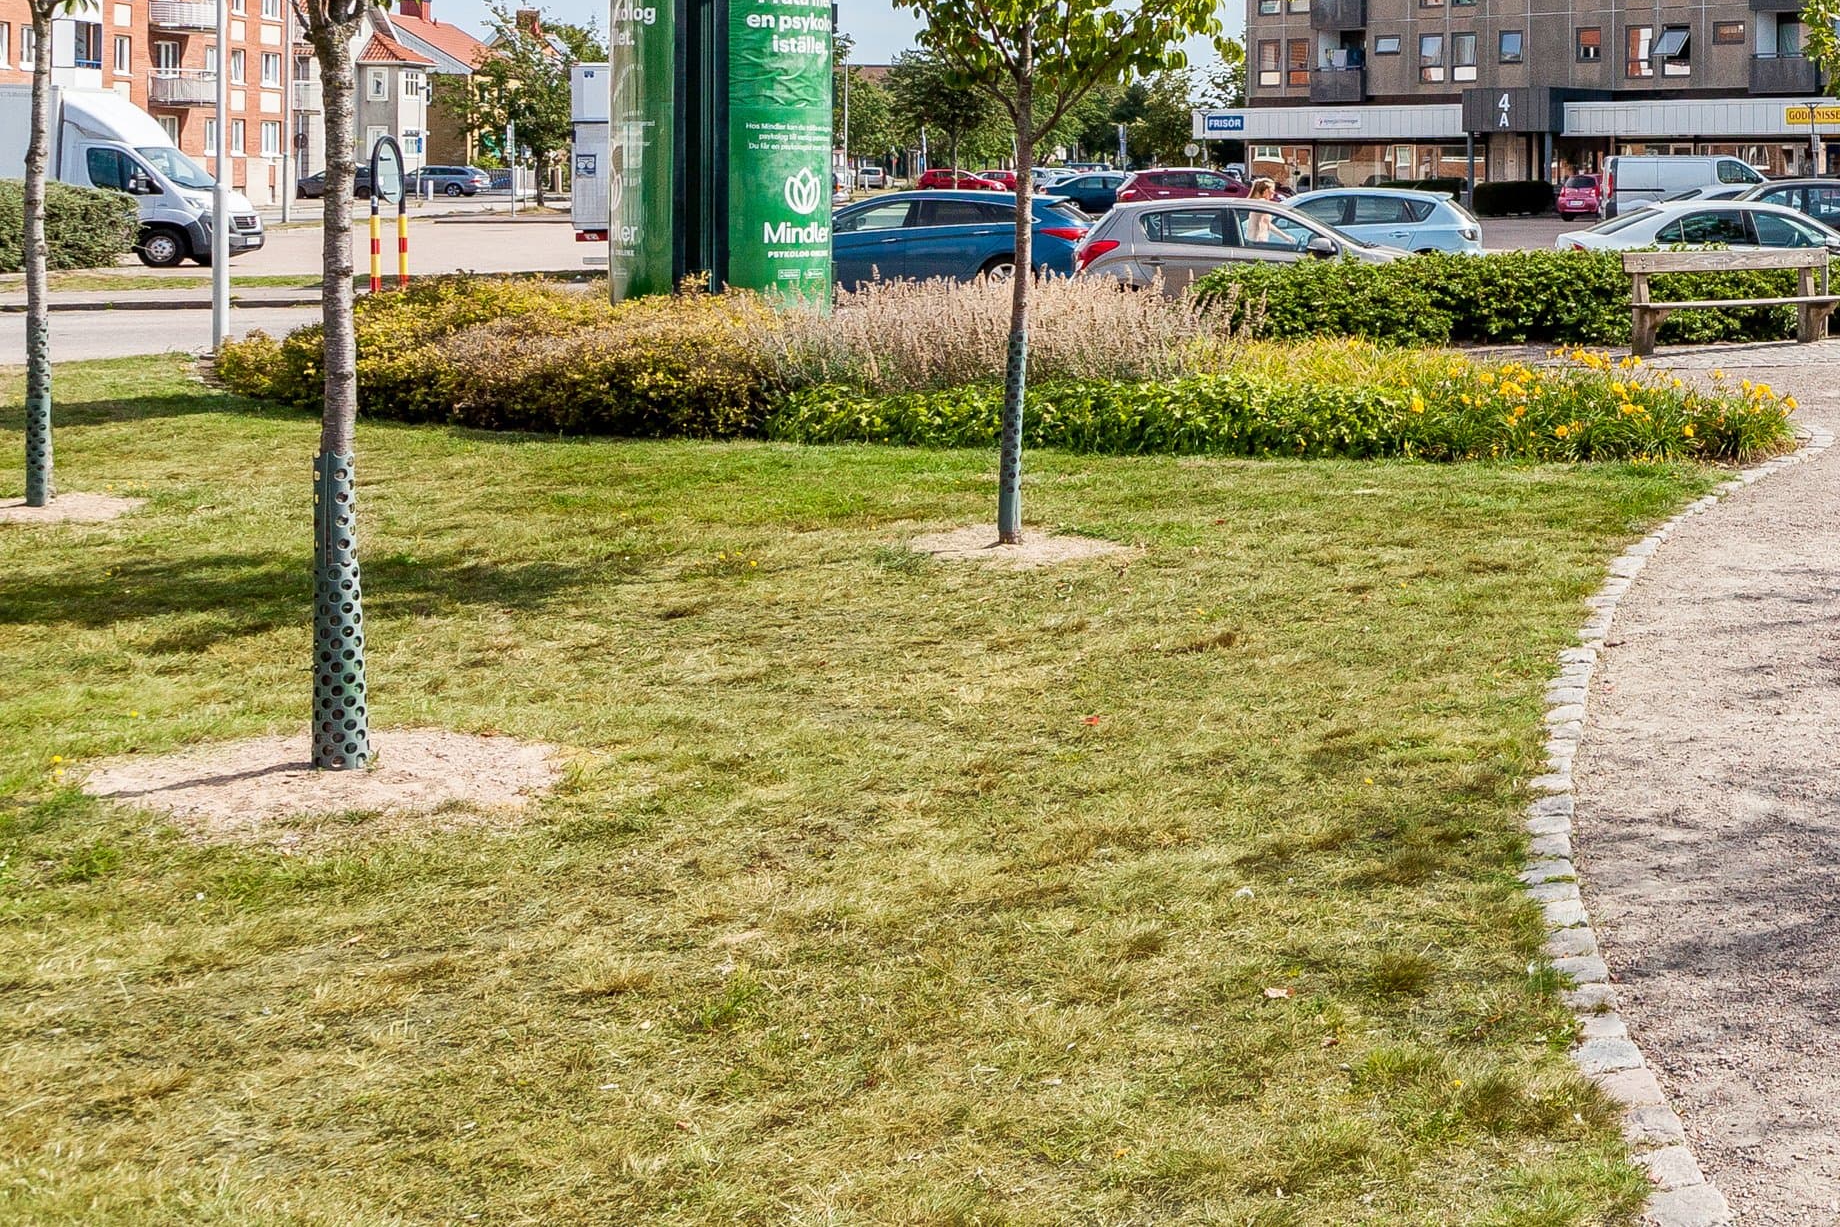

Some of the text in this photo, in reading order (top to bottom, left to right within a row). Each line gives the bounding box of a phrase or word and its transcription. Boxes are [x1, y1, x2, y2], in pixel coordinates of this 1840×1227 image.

[746, 14, 776, 28] en
[1498, 94, 1510, 111] 4
[1208, 118, 1242, 128] FRISÖR
[1499, 113, 1509, 127] A
[763, 222, 829, 244] Mindler
